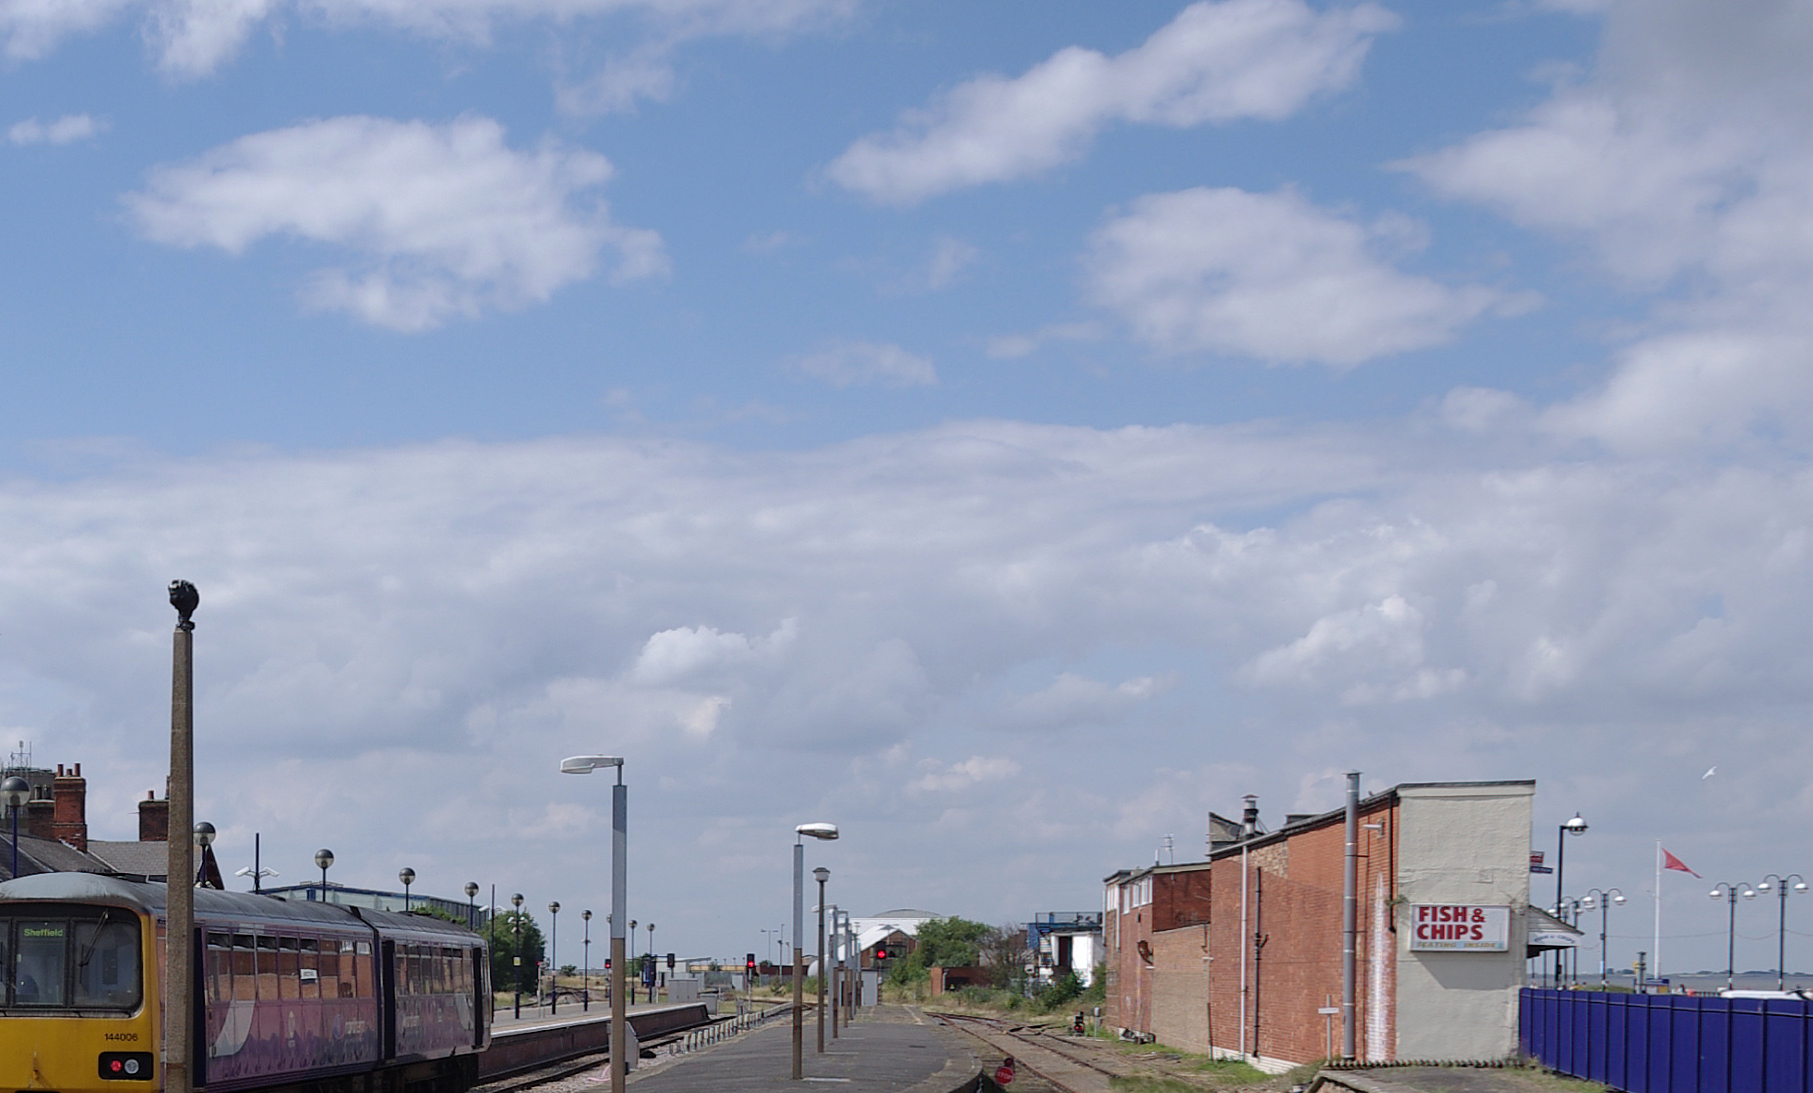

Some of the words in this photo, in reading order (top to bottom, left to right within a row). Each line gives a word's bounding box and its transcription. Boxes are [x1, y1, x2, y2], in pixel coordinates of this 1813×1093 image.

[1419, 906, 1467, 922] FISH
[1471, 908, 1485, 923] &
[24, 928, 64, 937] Sheffield
[1417, 923, 1483, 940] CHIPS
[105, 1033, 138, 1041] 144006
